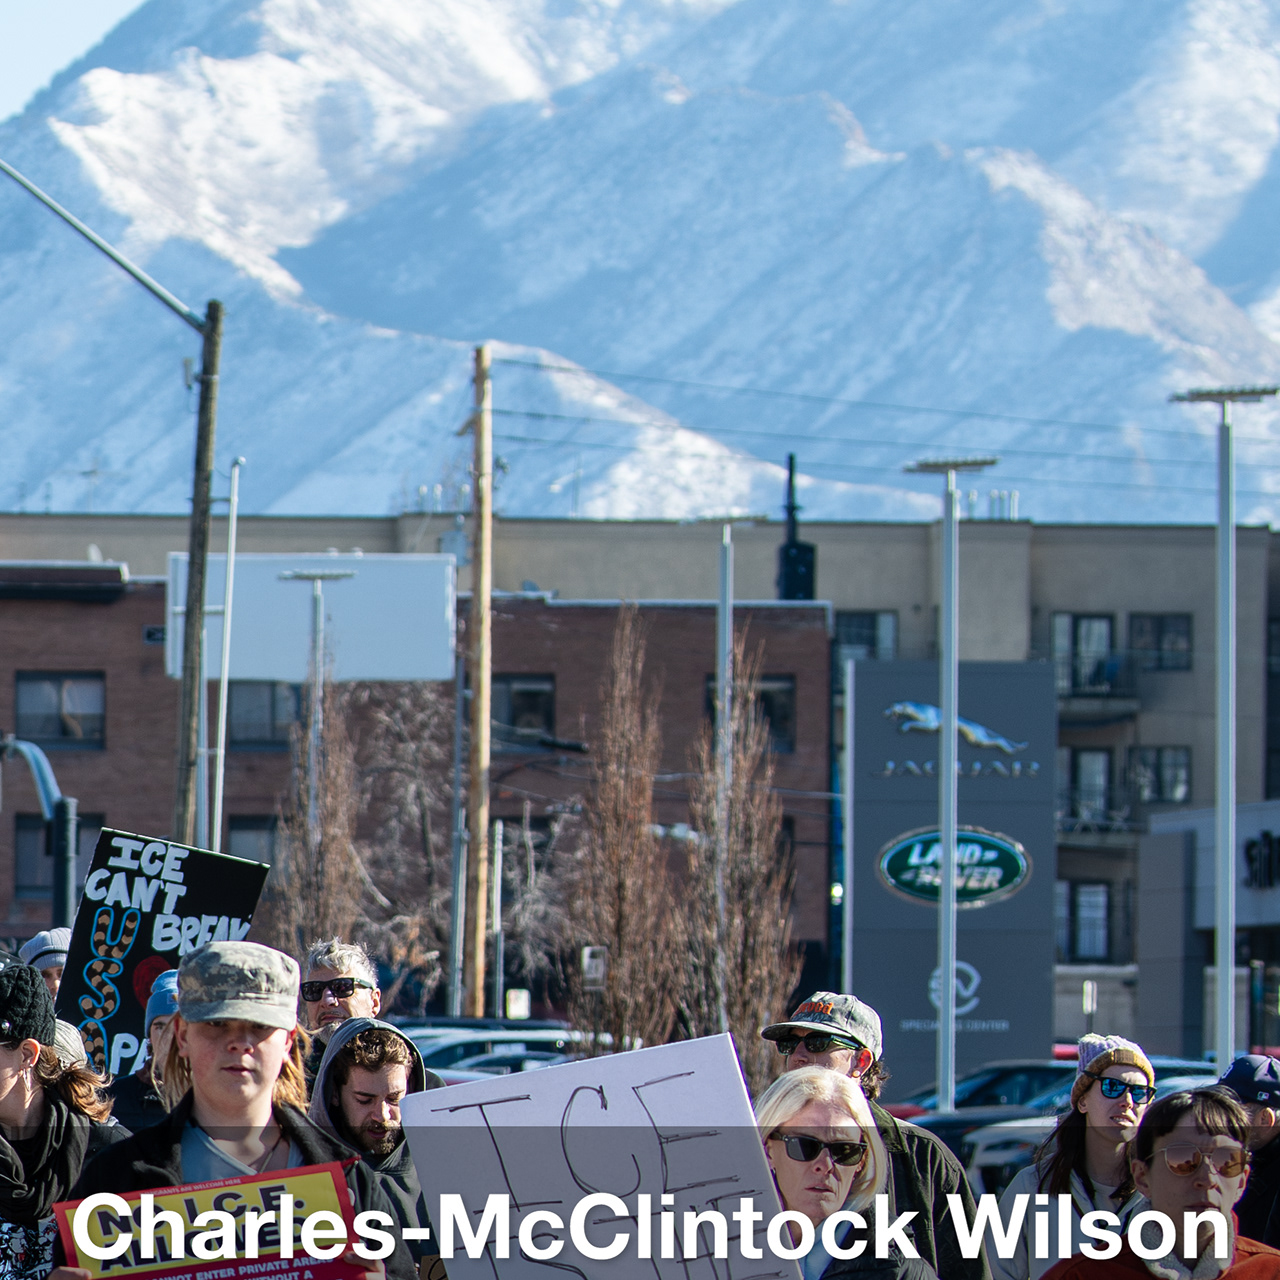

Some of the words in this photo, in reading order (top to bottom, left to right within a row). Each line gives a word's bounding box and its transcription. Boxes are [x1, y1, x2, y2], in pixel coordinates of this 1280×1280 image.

[107, 837, 189, 883] ICE
[908, 842, 983, 866] LAND
[915, 865, 1004, 889] ROVER
[85, 869, 187, 914] CAN'T
[430, 1071, 740, 1214] ICE
[239, 1260, 289, 1276] PRIVATE
[303, 1269, 313, 1280] A
